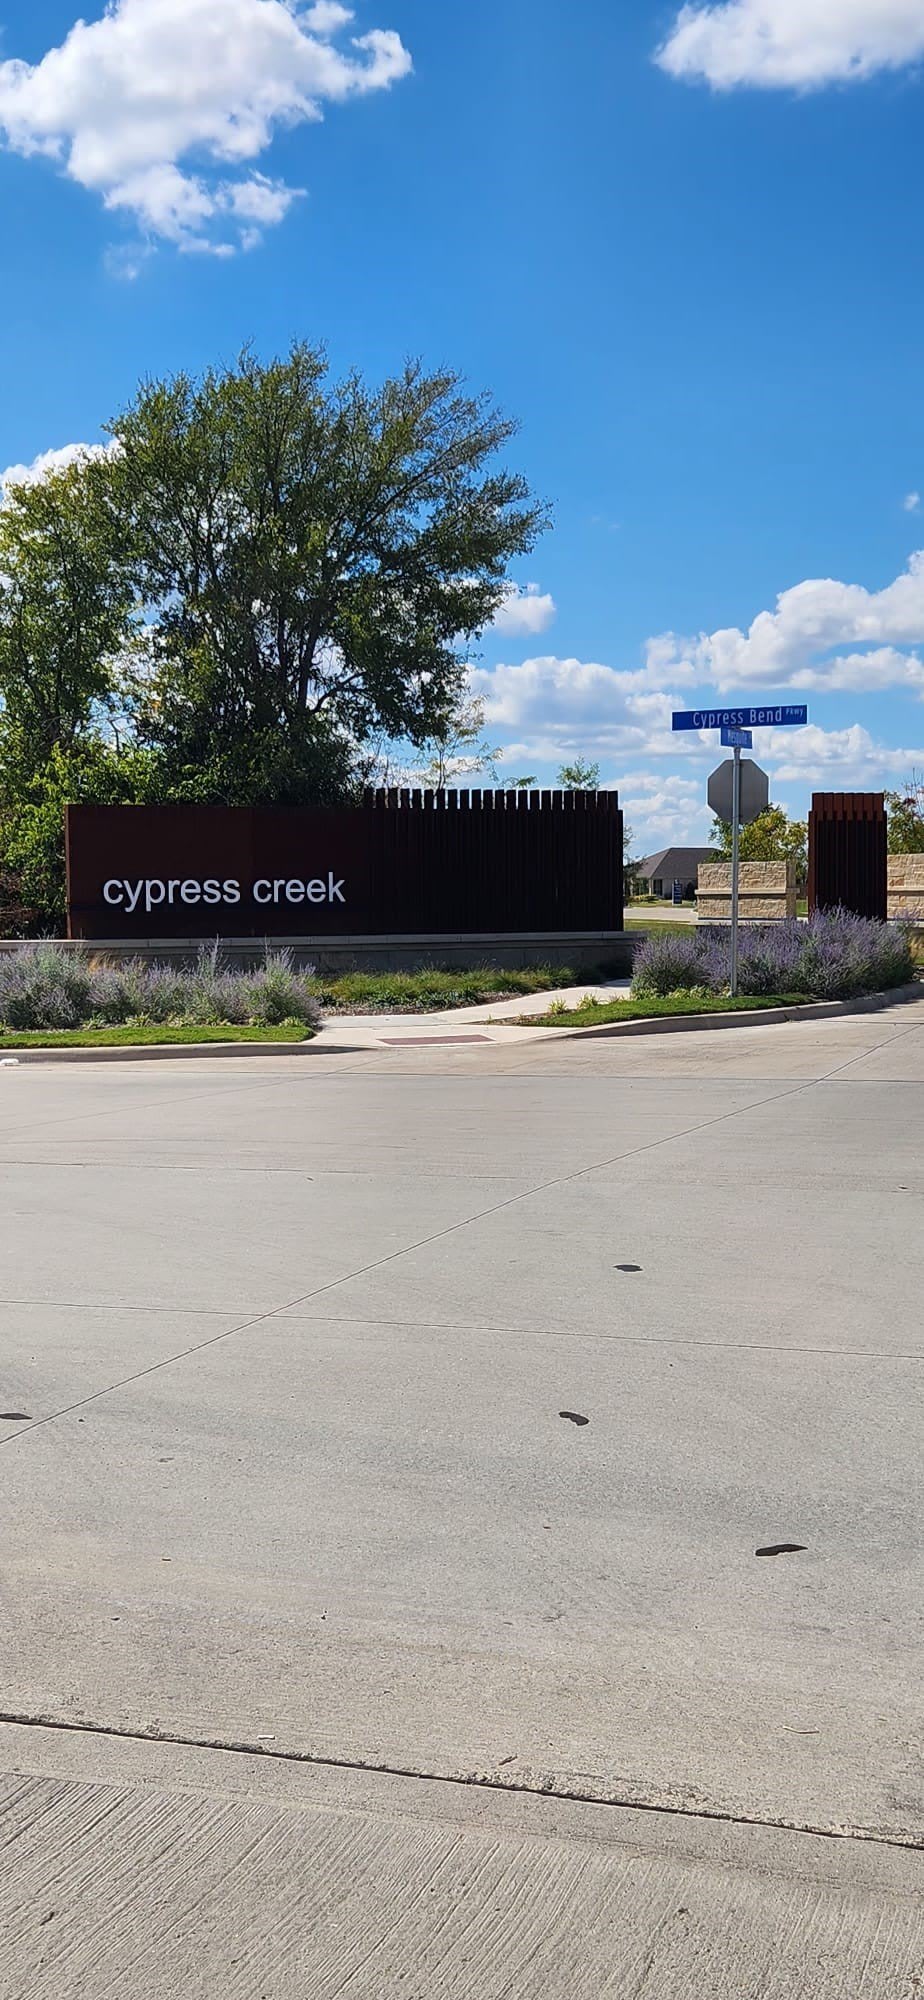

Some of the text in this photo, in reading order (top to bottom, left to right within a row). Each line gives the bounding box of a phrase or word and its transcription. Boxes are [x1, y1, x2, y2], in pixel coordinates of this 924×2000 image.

[692, 711, 744, 729] Cypress
[750, 708, 782, 723] Bend
[103, 872, 346, 912] cypress creek
